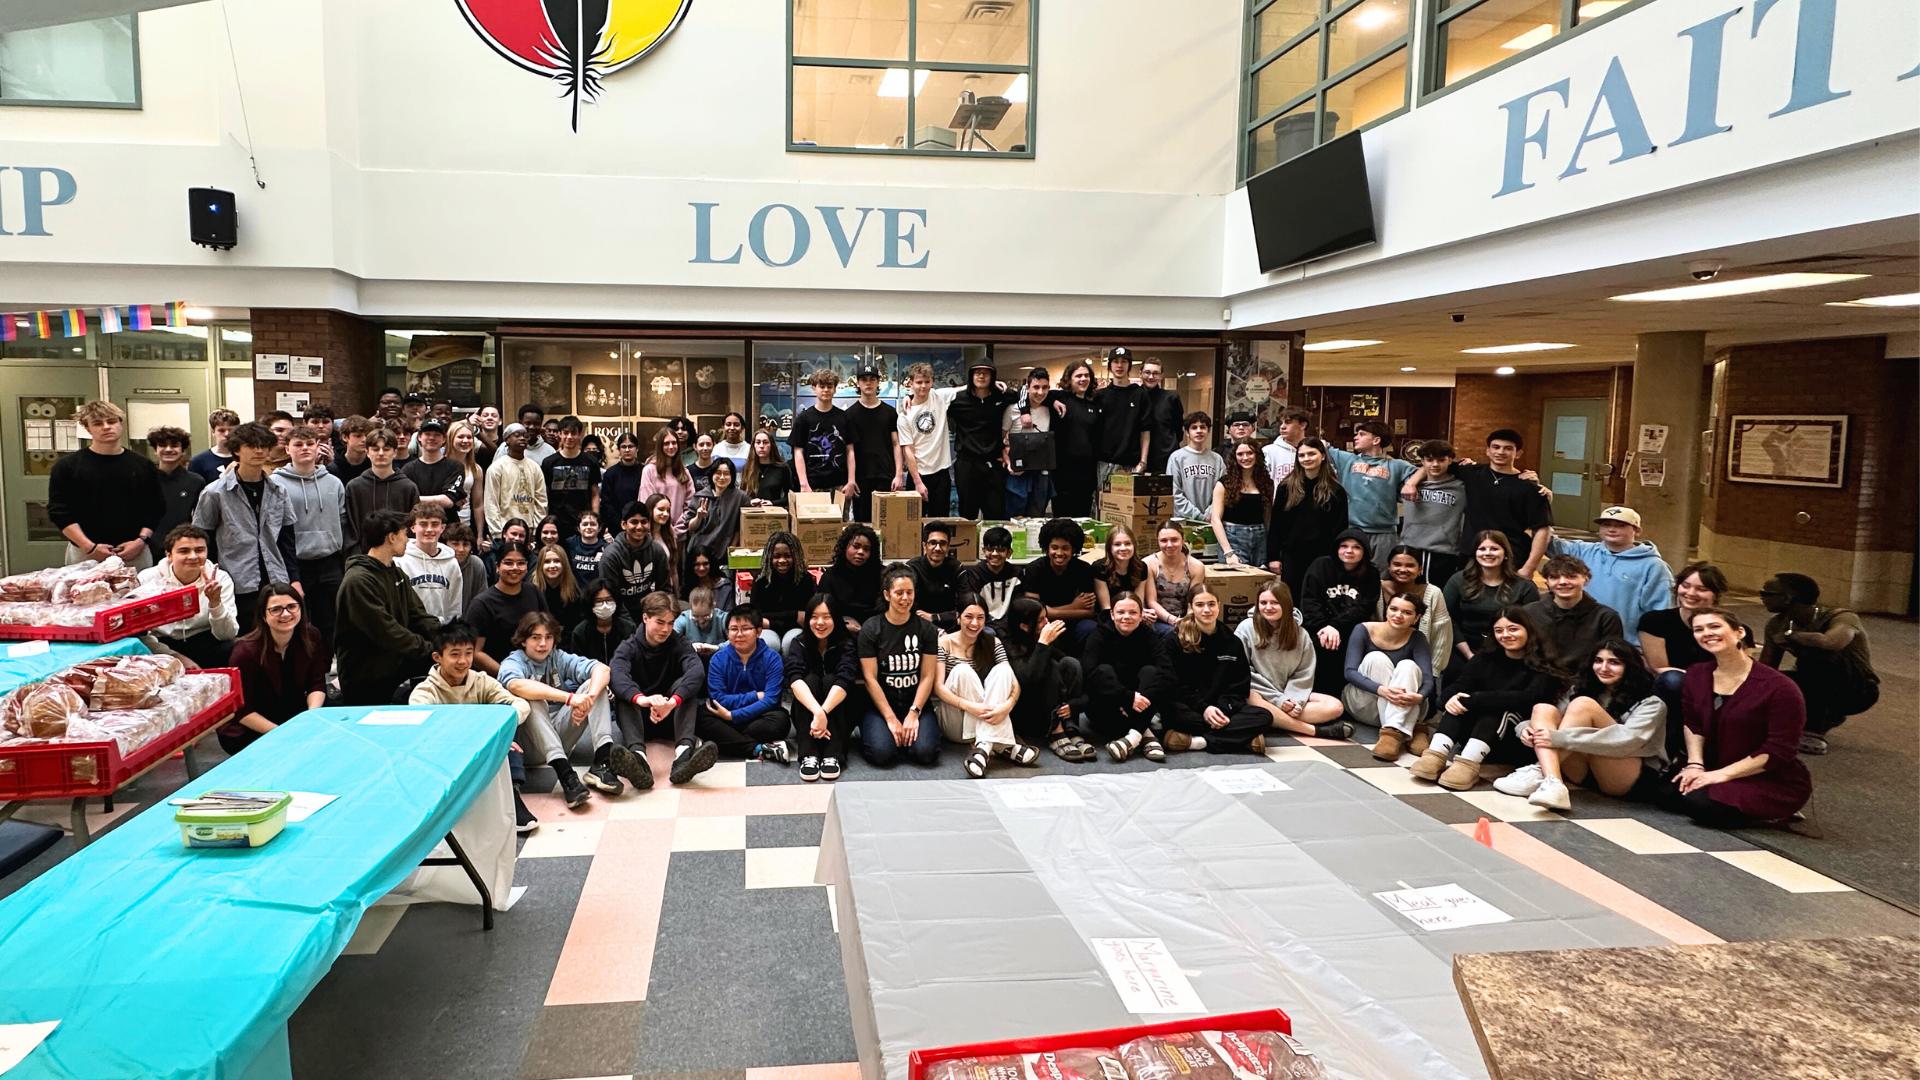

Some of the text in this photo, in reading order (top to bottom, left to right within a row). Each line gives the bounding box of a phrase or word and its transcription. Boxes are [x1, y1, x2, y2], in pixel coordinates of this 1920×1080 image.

[1492, 0, 1920, 198] FAIT
[688, 202, 930, 268] LOVE
[576, 563, 595, 571] EAGLE
[620, 582, 656, 596] adidas
[886, 675, 918, 688] 5000
